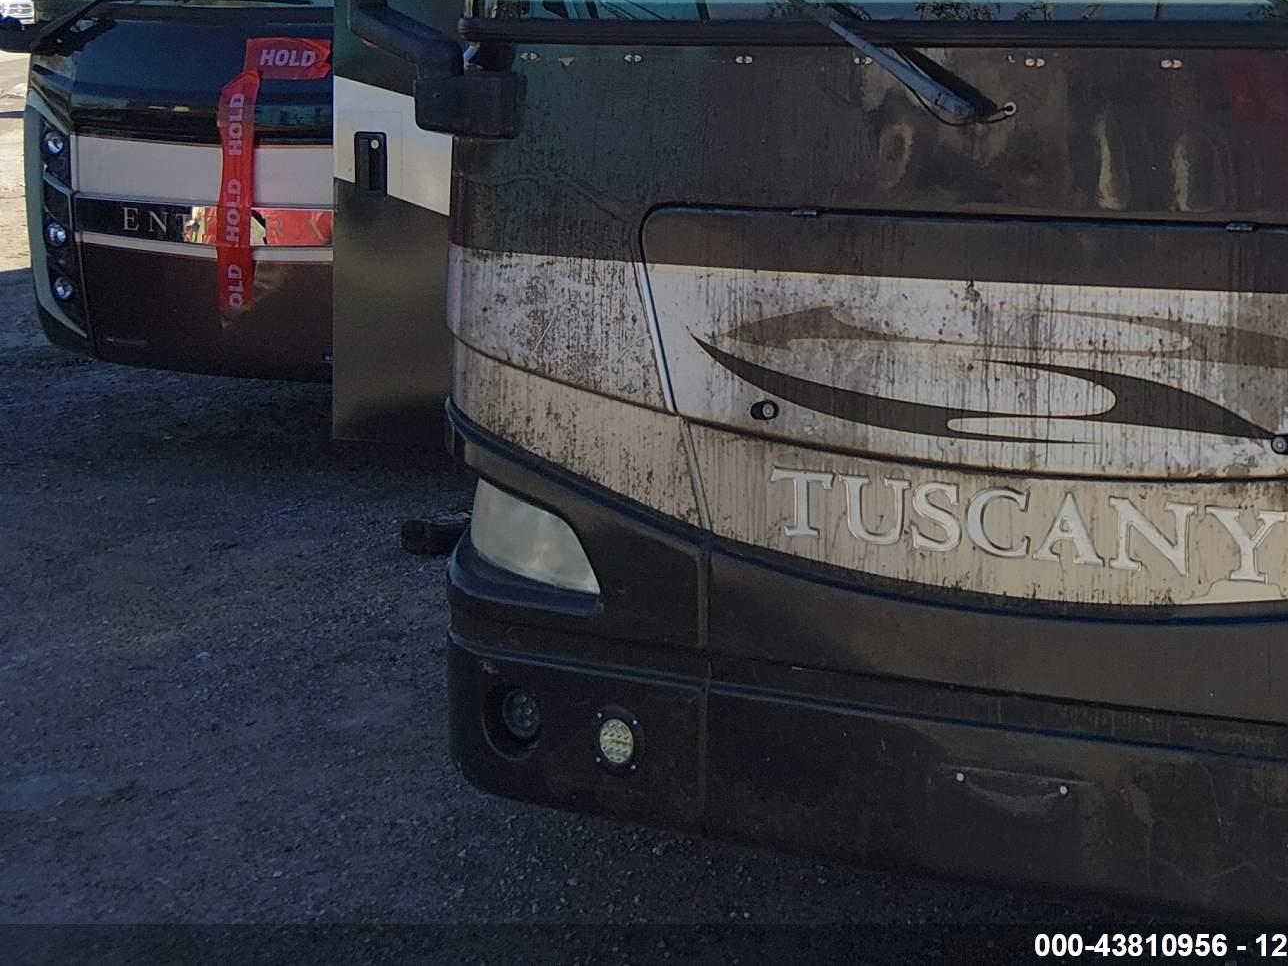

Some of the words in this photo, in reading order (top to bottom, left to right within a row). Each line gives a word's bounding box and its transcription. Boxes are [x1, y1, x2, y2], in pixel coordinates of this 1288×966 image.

[260, 49, 316, 67] HOLD
[228, 93, 245, 156] HOLD
[226, 178, 242, 243] HOLD
[226, 264, 244, 307] OLD
[770, 465, 1288, 584] TUSCANY
